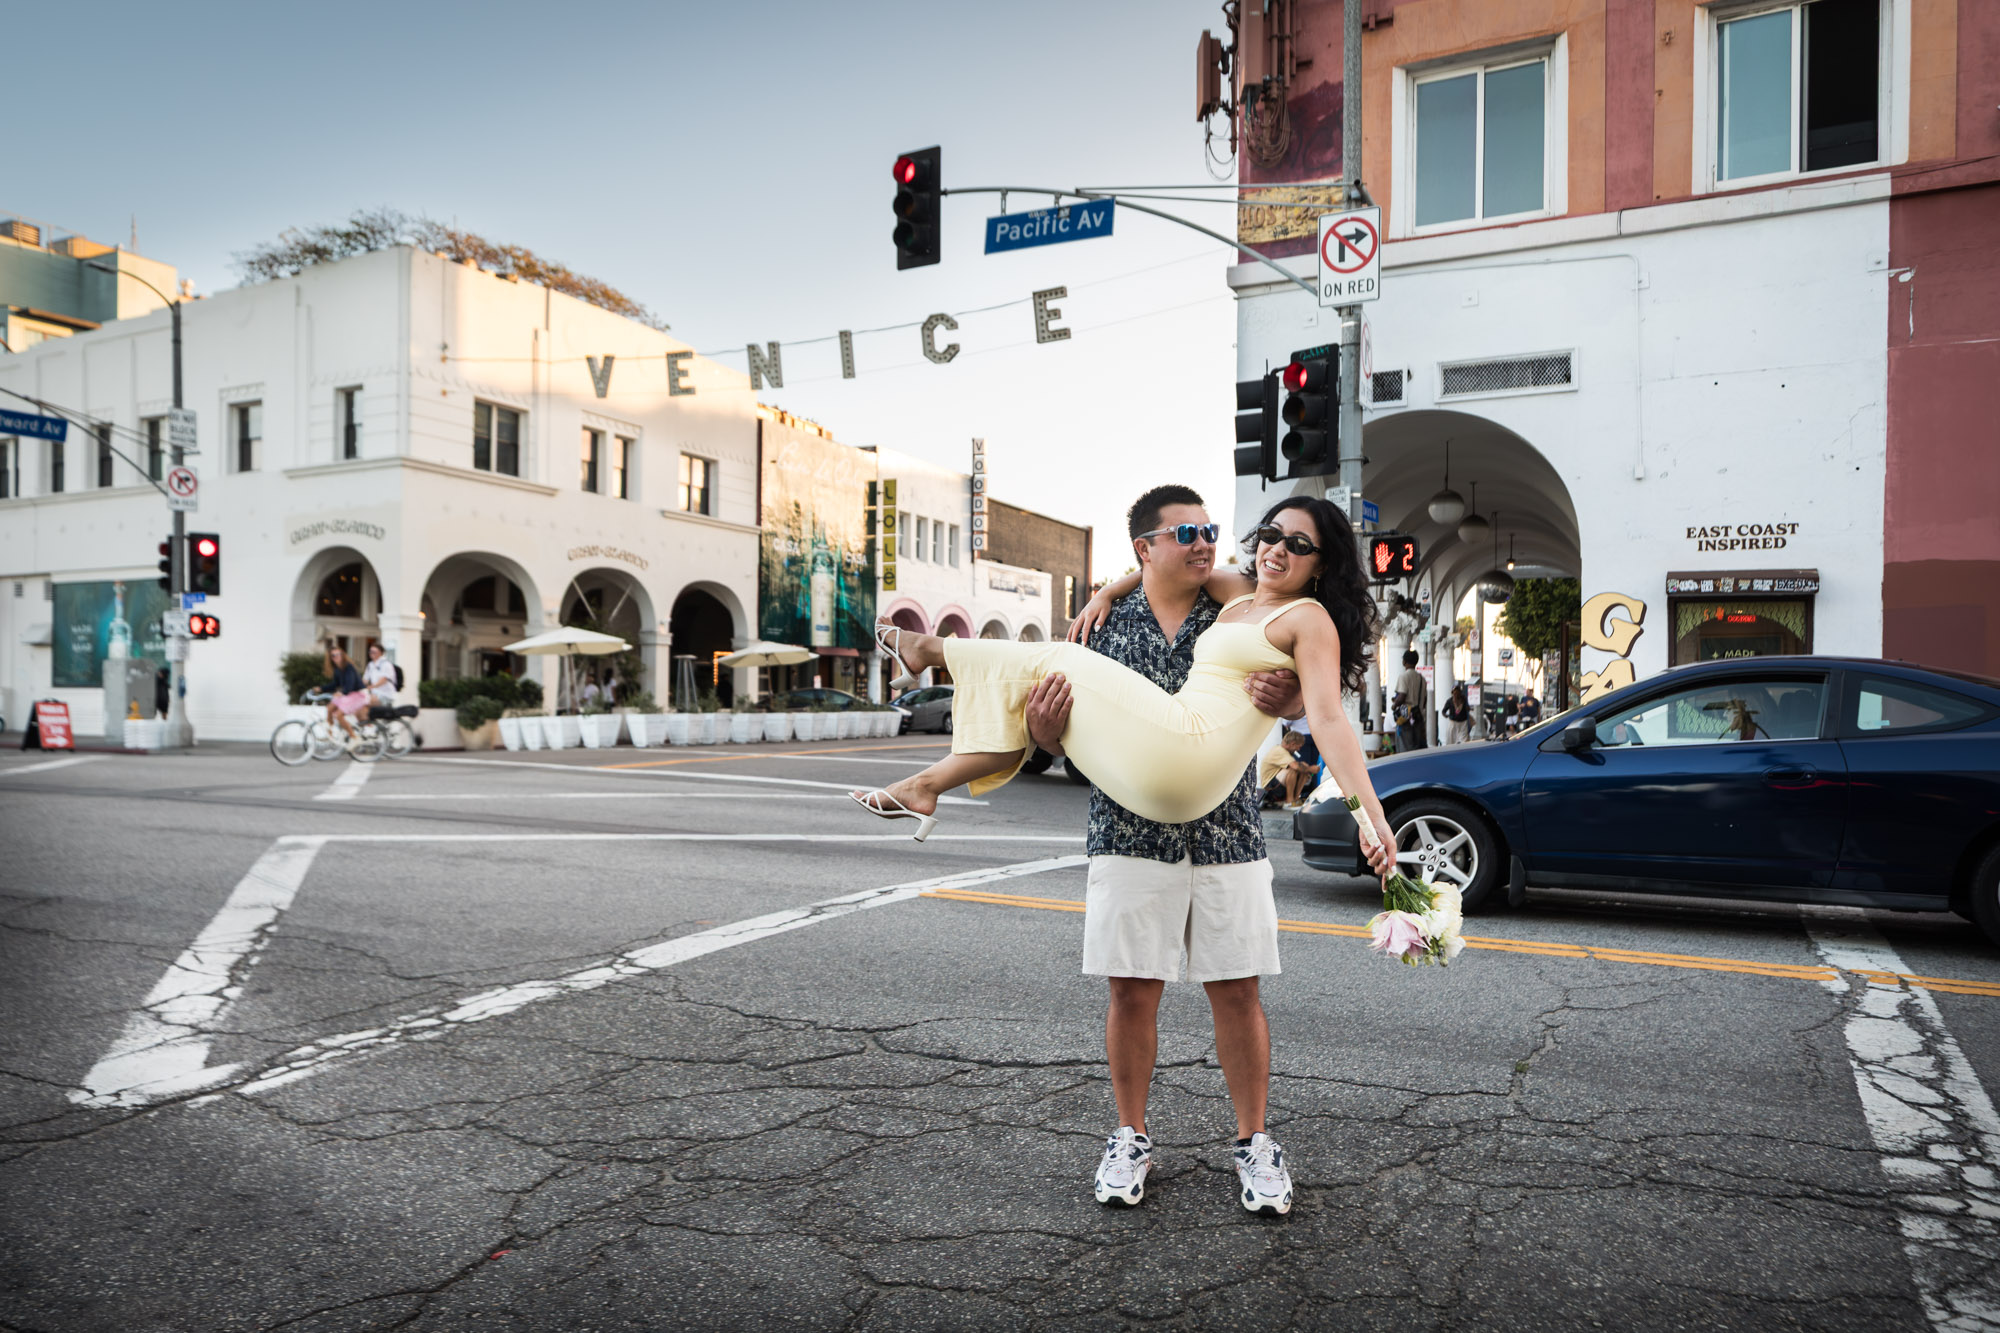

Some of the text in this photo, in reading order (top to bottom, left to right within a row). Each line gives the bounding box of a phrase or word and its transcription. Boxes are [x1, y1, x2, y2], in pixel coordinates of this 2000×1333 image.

[996, 214, 1070, 243] Pacific
[1077, 209, 1105, 230] Av
[1324, 277, 1375, 298] ON RED
[586, 285, 1071, 399] VENICE
[42, 420, 62, 436] Av
[975, 441, 984, 548] VOODOO
[1686, 522, 1799, 539] EAST COAST
[773, 538, 799, 553] CASA
[1697, 536, 1787, 551] INSPIRED
[846, 551, 868, 566] CASA
[1402, 543, 1414, 571] 2
[205, 616, 217, 635] 2
[1724, 648, 1756, 659] MADE
